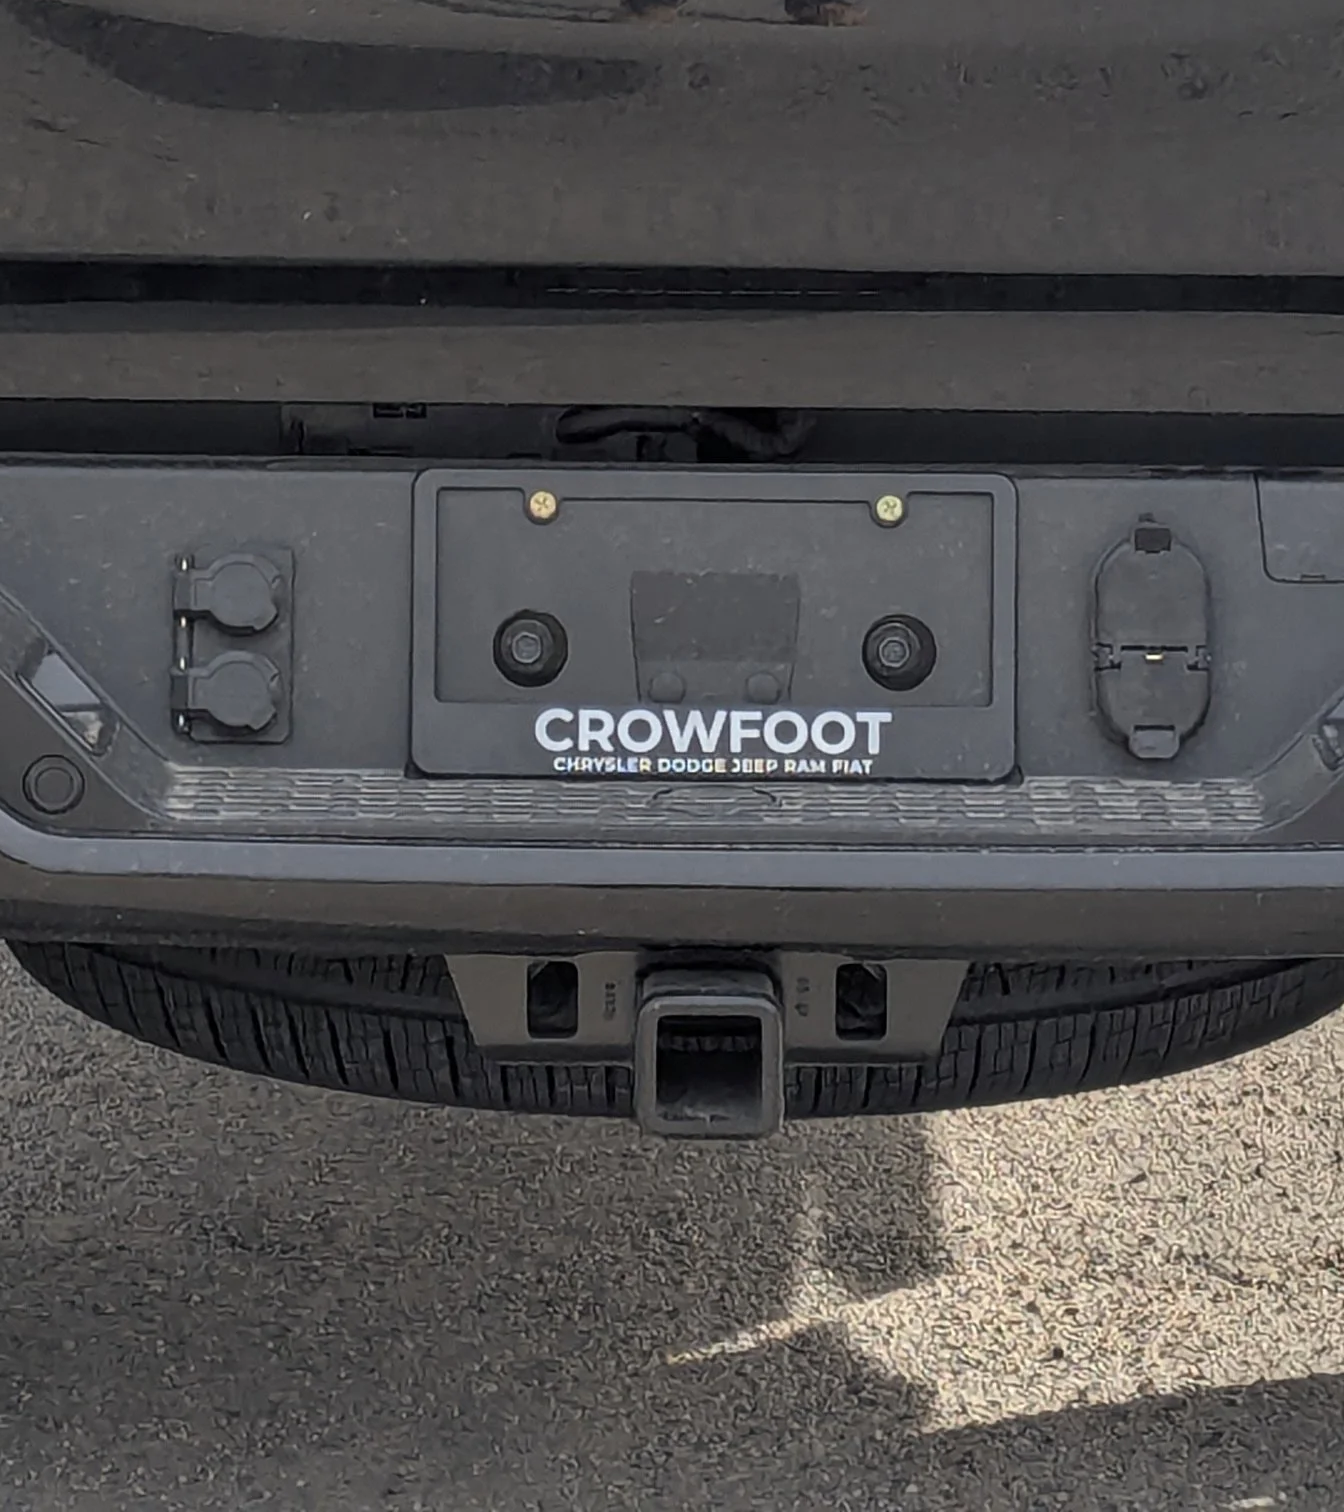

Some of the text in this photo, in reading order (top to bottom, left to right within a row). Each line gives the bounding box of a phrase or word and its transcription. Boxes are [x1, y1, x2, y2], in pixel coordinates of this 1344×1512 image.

[534, 707, 893, 755] CROWFOOT
[553, 756, 874, 775] CHRYSLER DODGE JEEP RAM FIAT
